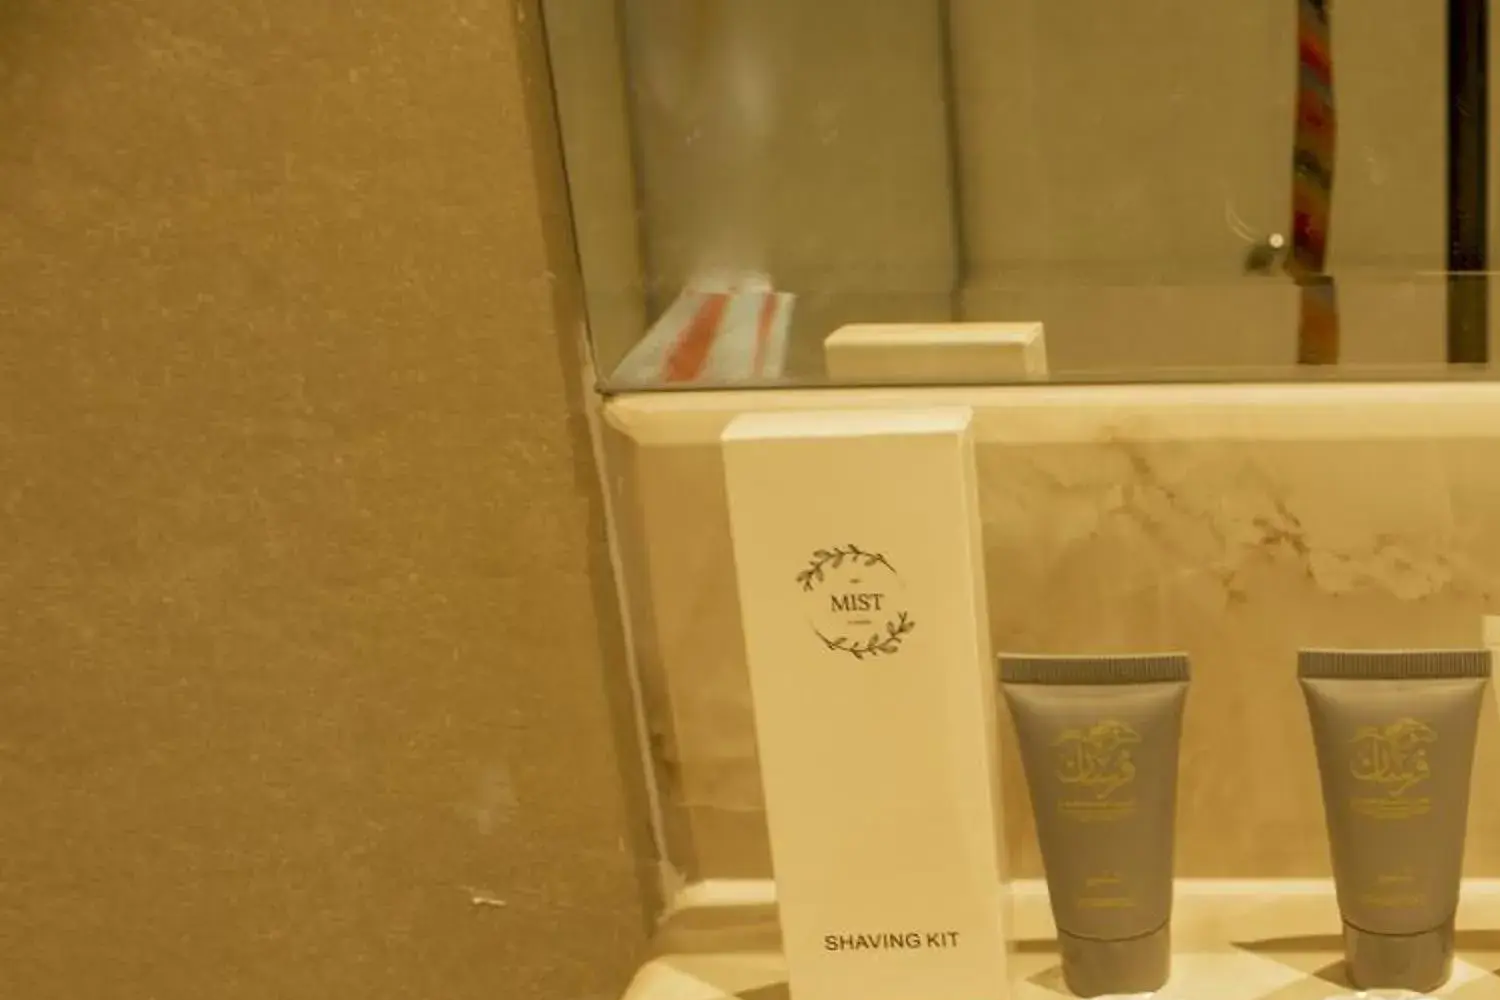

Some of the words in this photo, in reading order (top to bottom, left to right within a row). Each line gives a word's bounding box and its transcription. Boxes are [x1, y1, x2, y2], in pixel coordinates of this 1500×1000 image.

[829, 593, 885, 612] MIST
[824, 932, 922, 951] SHAVING
[926, 930, 960, 949] KIT
